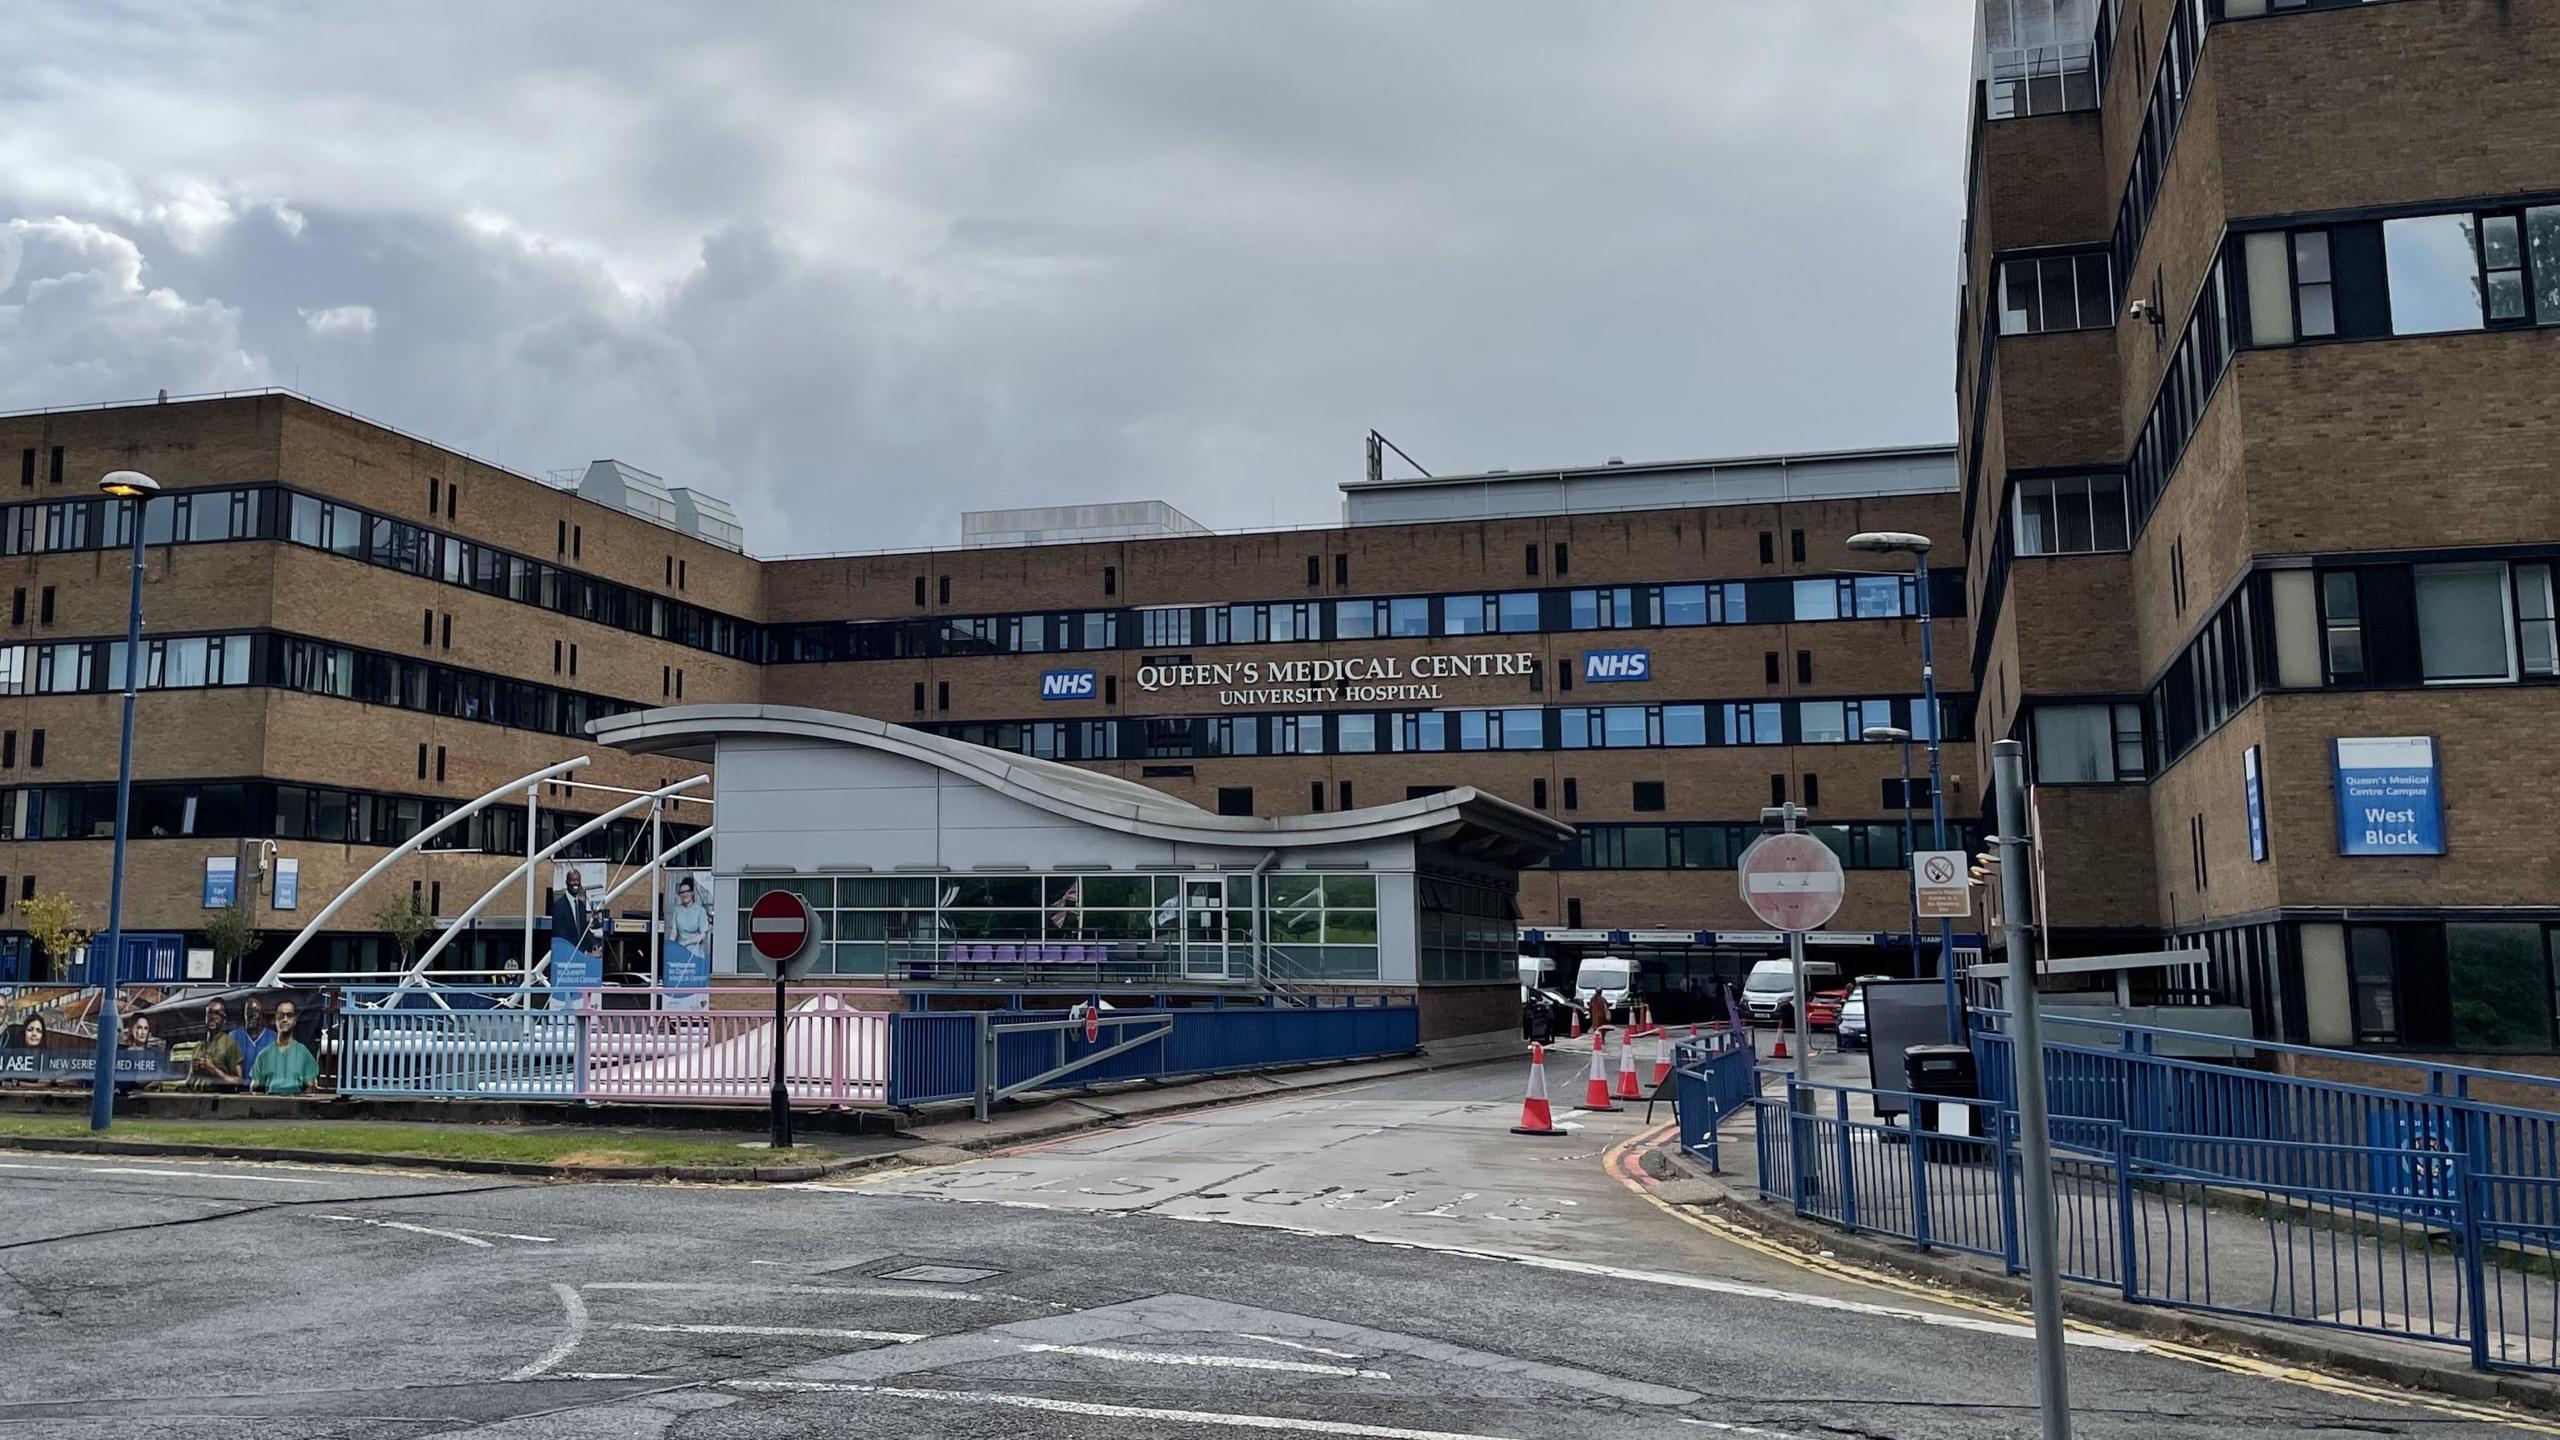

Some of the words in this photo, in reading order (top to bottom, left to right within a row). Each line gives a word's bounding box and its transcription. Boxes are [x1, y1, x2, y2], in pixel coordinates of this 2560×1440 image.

[1136, 661, 1259, 691] QUEEN'S
[1267, 658, 1403, 684] MEDICAL
[1410, 653, 1534, 678] CENTRE
[1587, 654, 1646, 677] NHS
[1043, 674, 1093, 694] NHS
[1219, 687, 1340, 705] UNIVERSITY
[1345, 684, 1443, 702] HOSPITAL
[2345, 776, 2387, 786] Queen's
[2389, 776, 2429, 785] Medical
[2350, 787, 2384, 796] Centre
[2386, 787, 2427, 797] Campus
[2364, 808, 2415, 823] West
[2365, 829, 2419, 845] Block
[6, 1056, 34, 1071] A&E
[50, 1060, 69, 1069] NEW
[134, 1060, 156, 1071] HERE
